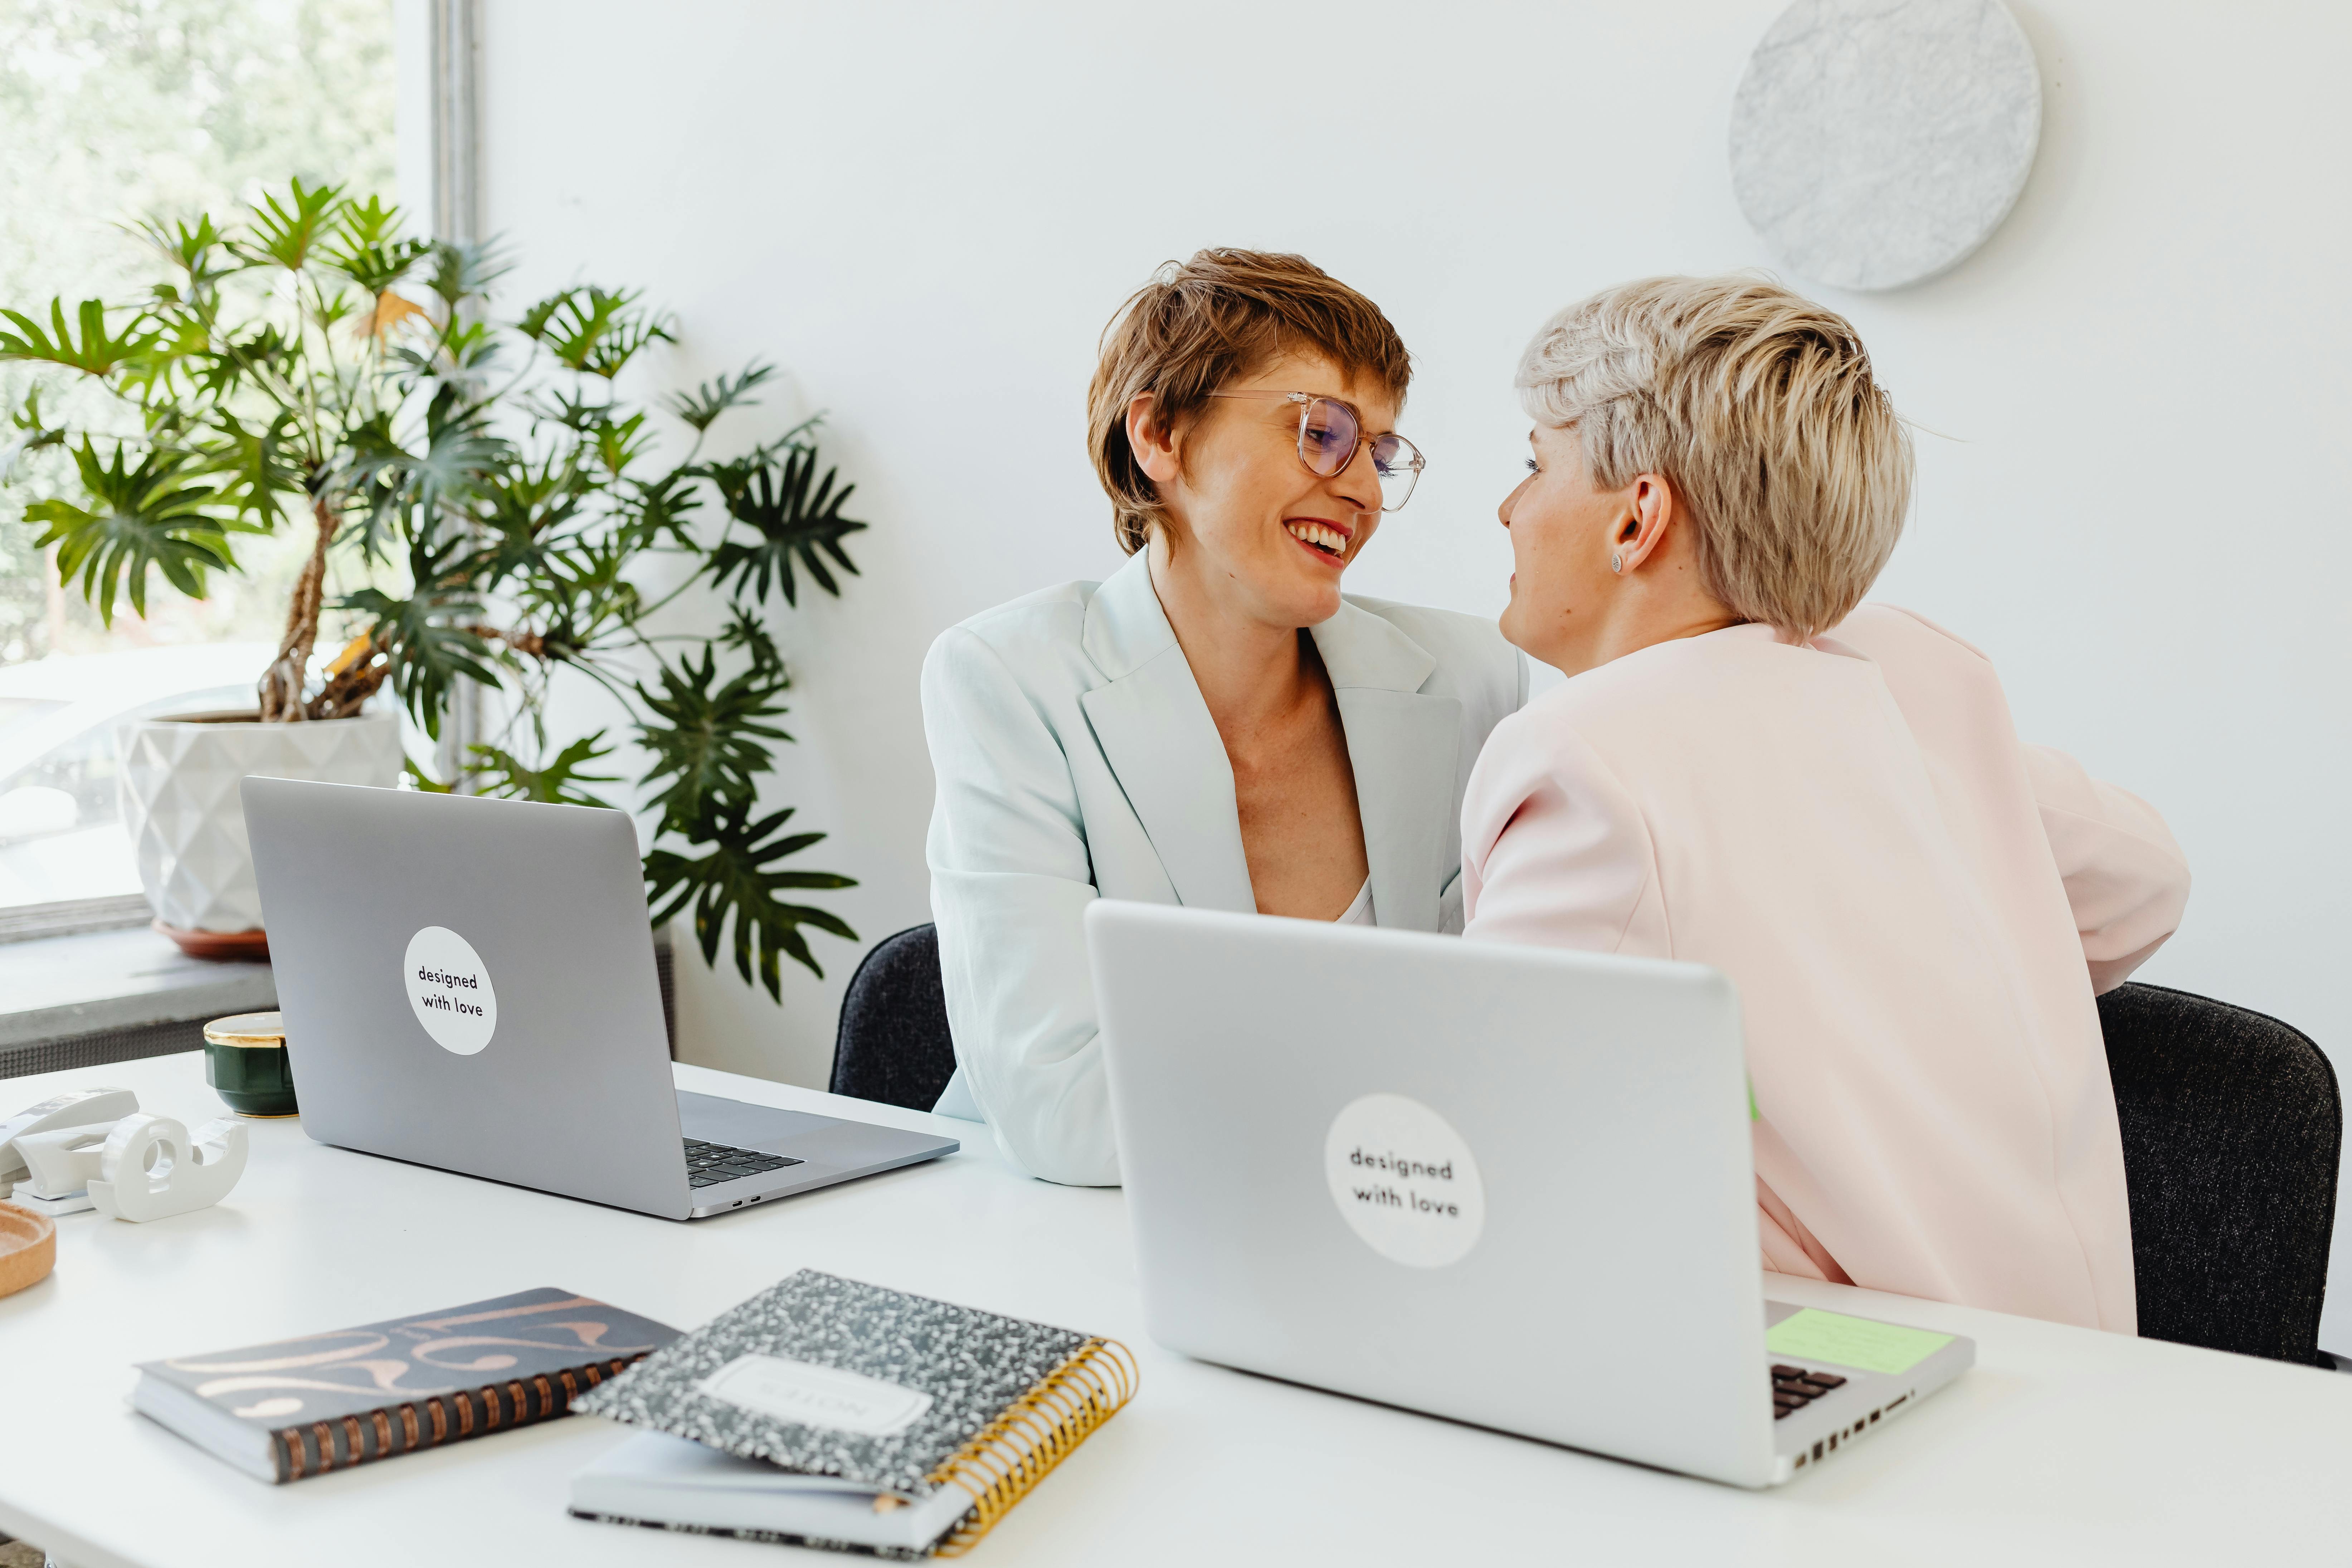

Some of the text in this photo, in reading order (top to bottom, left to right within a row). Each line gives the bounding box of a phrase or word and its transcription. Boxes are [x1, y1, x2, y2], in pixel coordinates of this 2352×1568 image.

[419, 965, 478, 989] designed
[422, 994, 483, 1017] with love
[1349, 1146, 1454, 1181] designed
[1353, 1184, 1459, 1218] with love
[757, 1382, 870, 1418] NOTES
